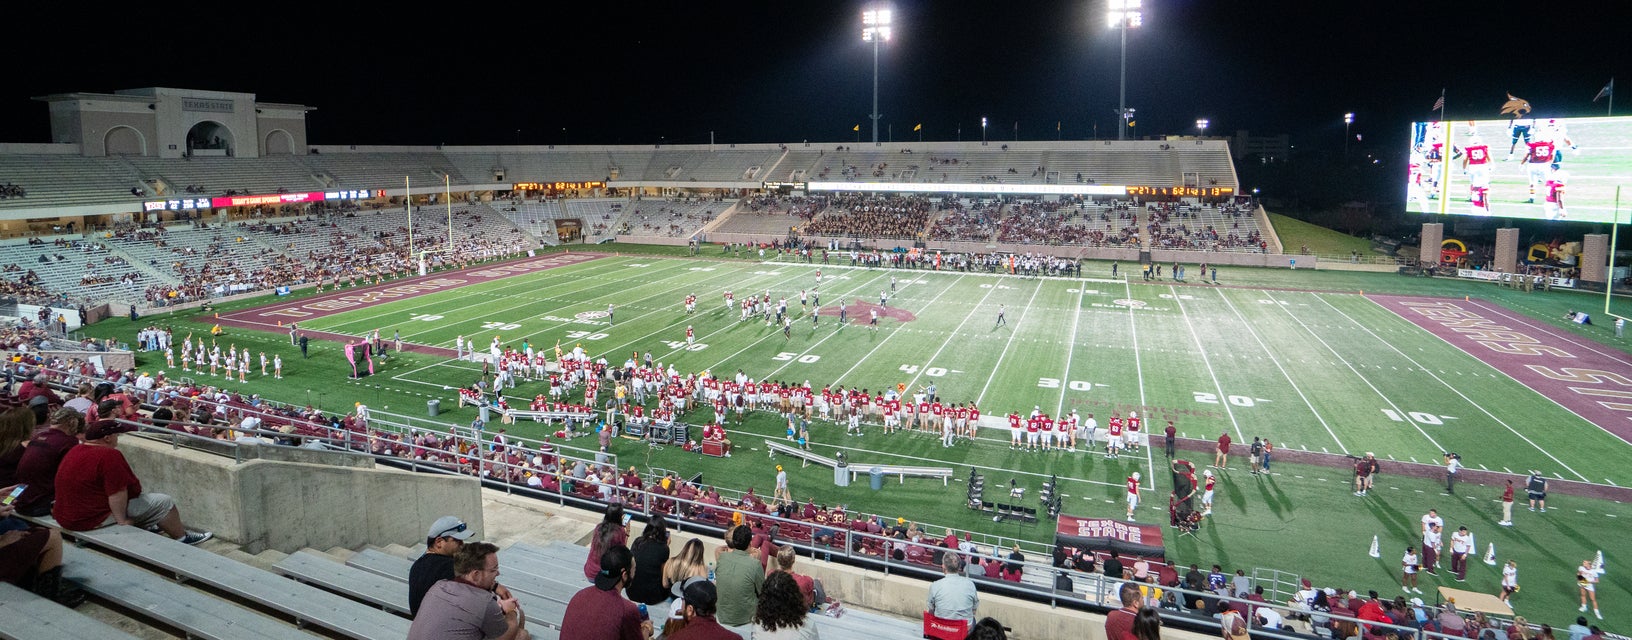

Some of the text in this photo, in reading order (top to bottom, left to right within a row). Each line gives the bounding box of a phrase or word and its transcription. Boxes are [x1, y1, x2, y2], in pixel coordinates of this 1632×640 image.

[184, 101, 233, 110] TEXAS STATE
[1399, 301, 1577, 358] TEXAS
[772, 352, 821, 363] 50
[898, 364, 947, 376] 40
[1037, 378, 1091, 391] 30
[1193, 391, 1254, 407] 20
[1380, 408, 1444, 425] 10
[833, 513, 843, 523] 33
[1077, 519, 1141, 534] TEXAS
[1078, 526, 1142, 544] STATE
